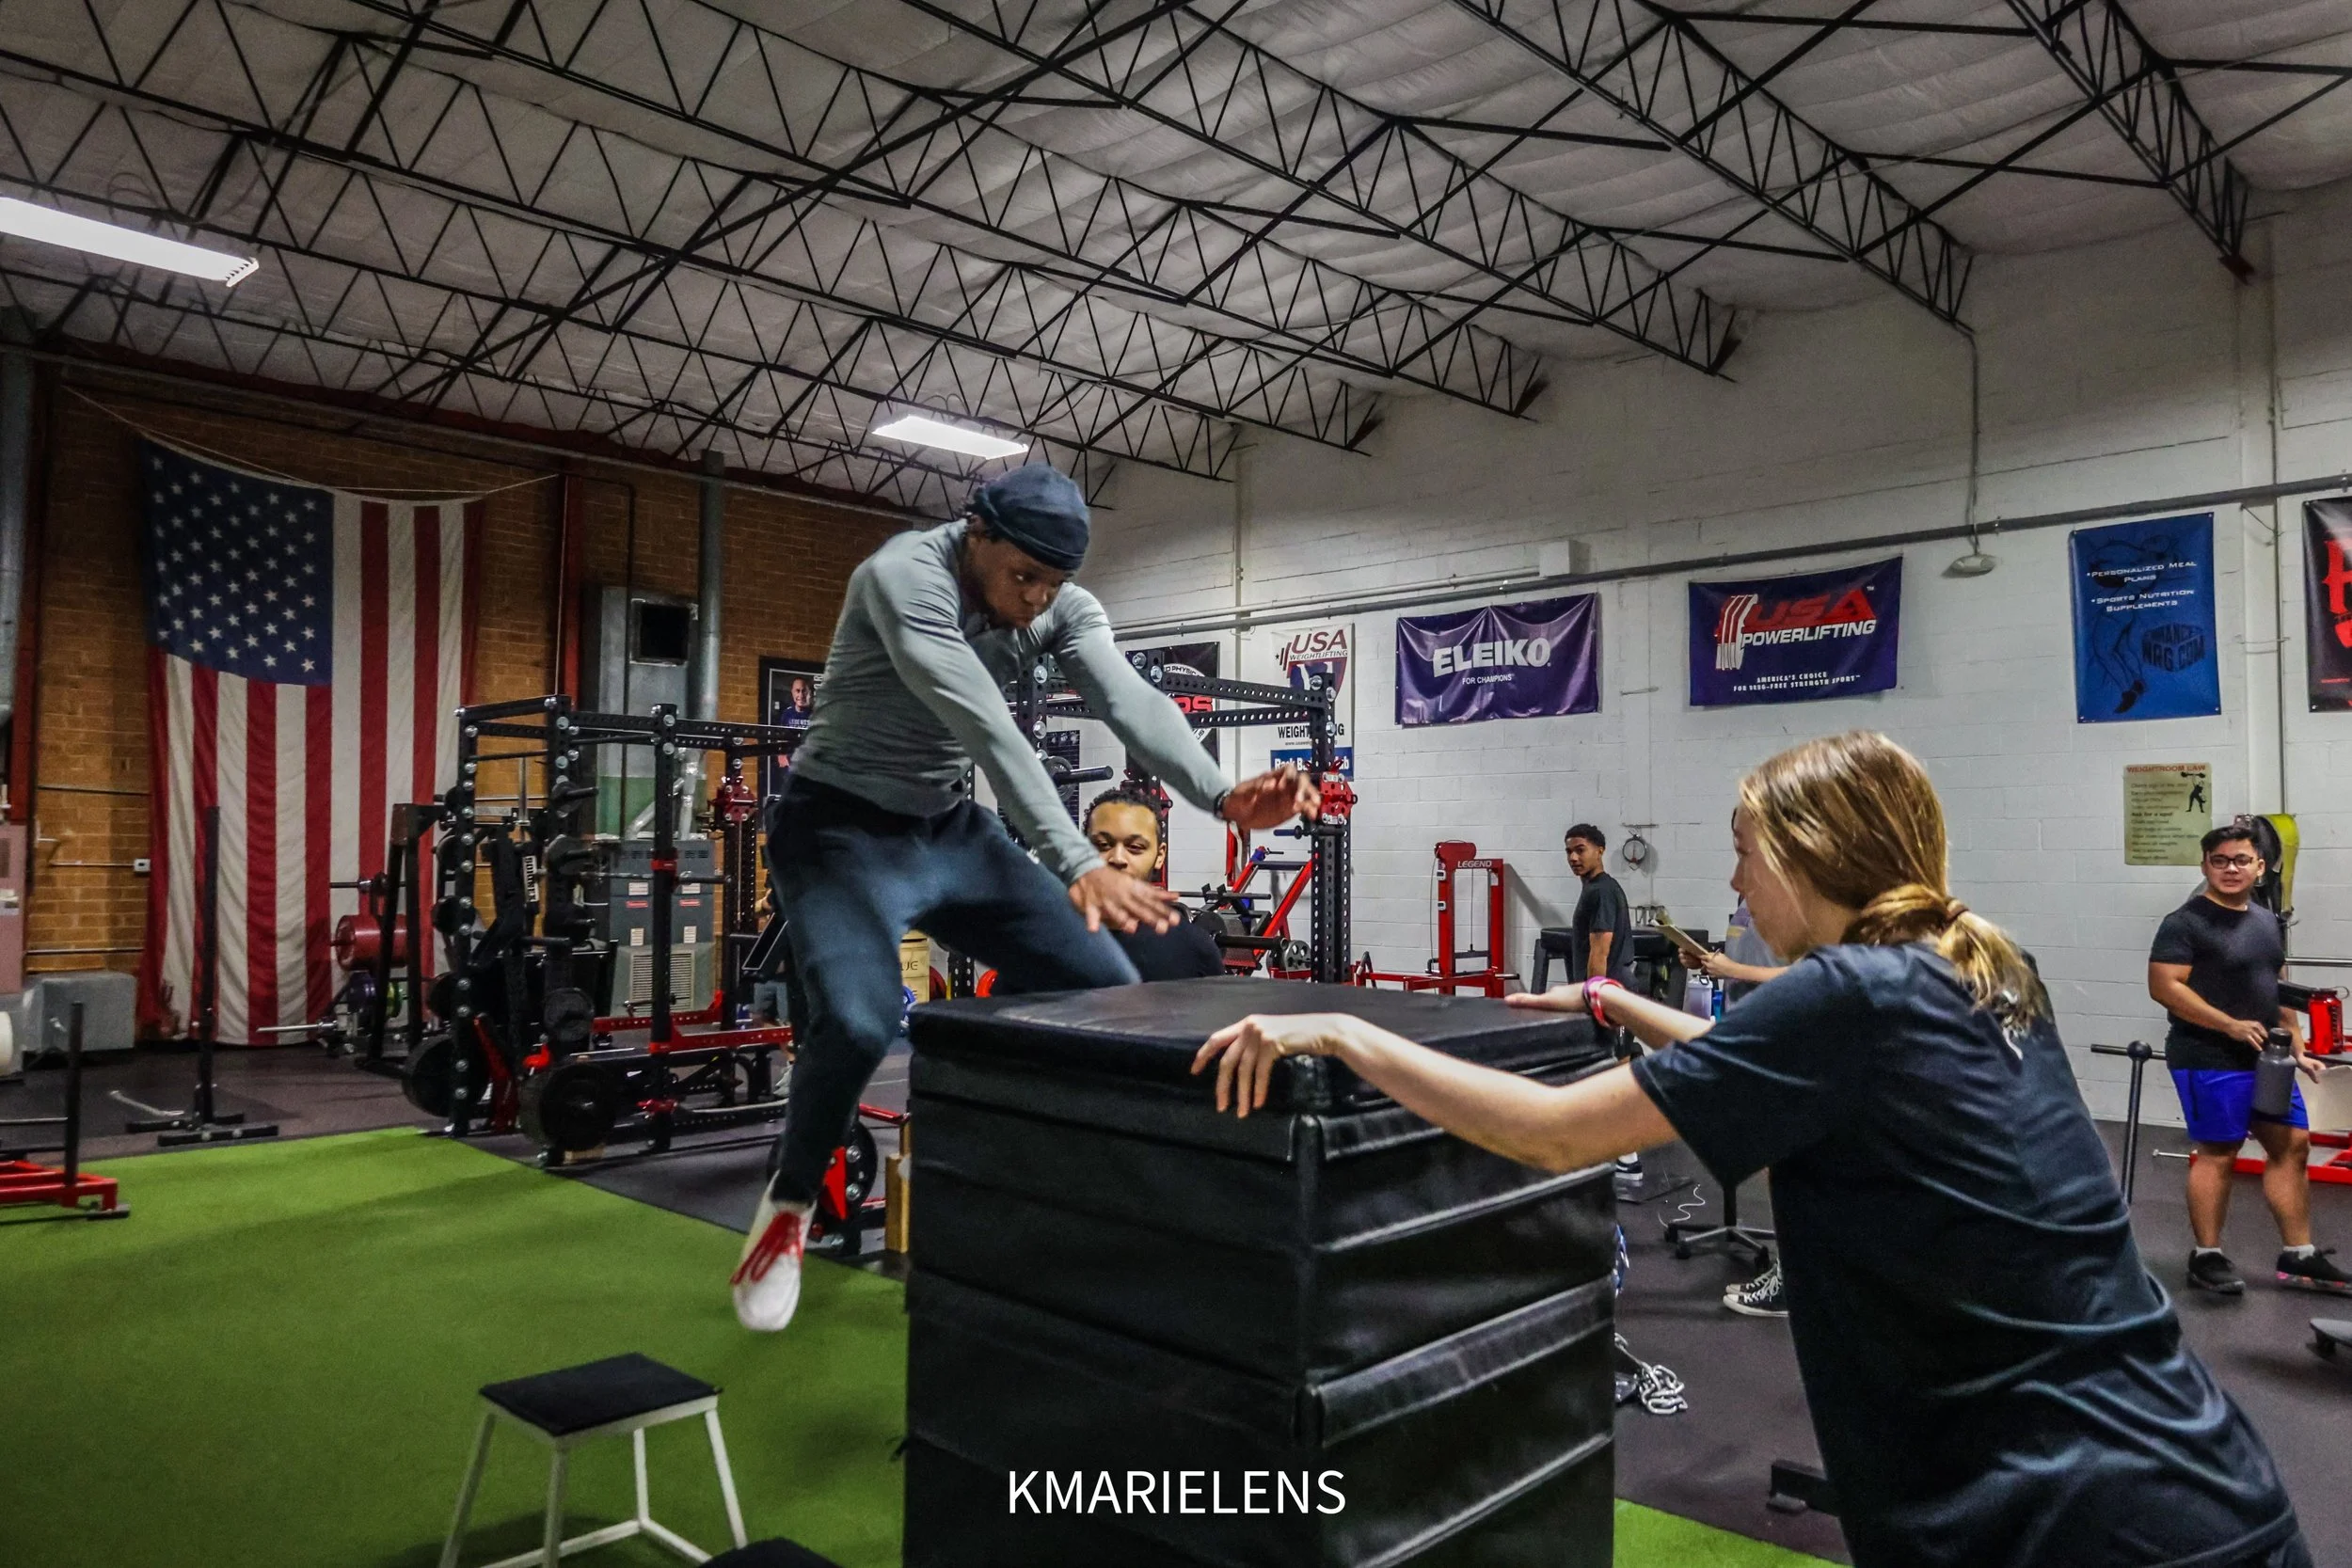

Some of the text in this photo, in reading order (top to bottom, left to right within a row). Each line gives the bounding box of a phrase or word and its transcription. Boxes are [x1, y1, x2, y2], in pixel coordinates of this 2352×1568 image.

[2124, 575, 2156, 583] PLANS
[2096, 590, 2195, 605] SPORTS NUTRITION
[1741, 587, 1876, 633] USA
[2106, 600, 2178, 612] SUPPLEMENTS
[1741, 620, 1876, 648] POWERLIFTING
[1291, 629, 1348, 655] USA
[1290, 650, 1348, 661] WEIGHTLIFTING
[1433, 638, 1550, 677] ELEIKO
[1477, 673, 1512, 684] CHAMPIONS
[1756, 672, 1827, 684] AMERICA'S CHOICE
[1457, 860, 1492, 868] LEGEND
